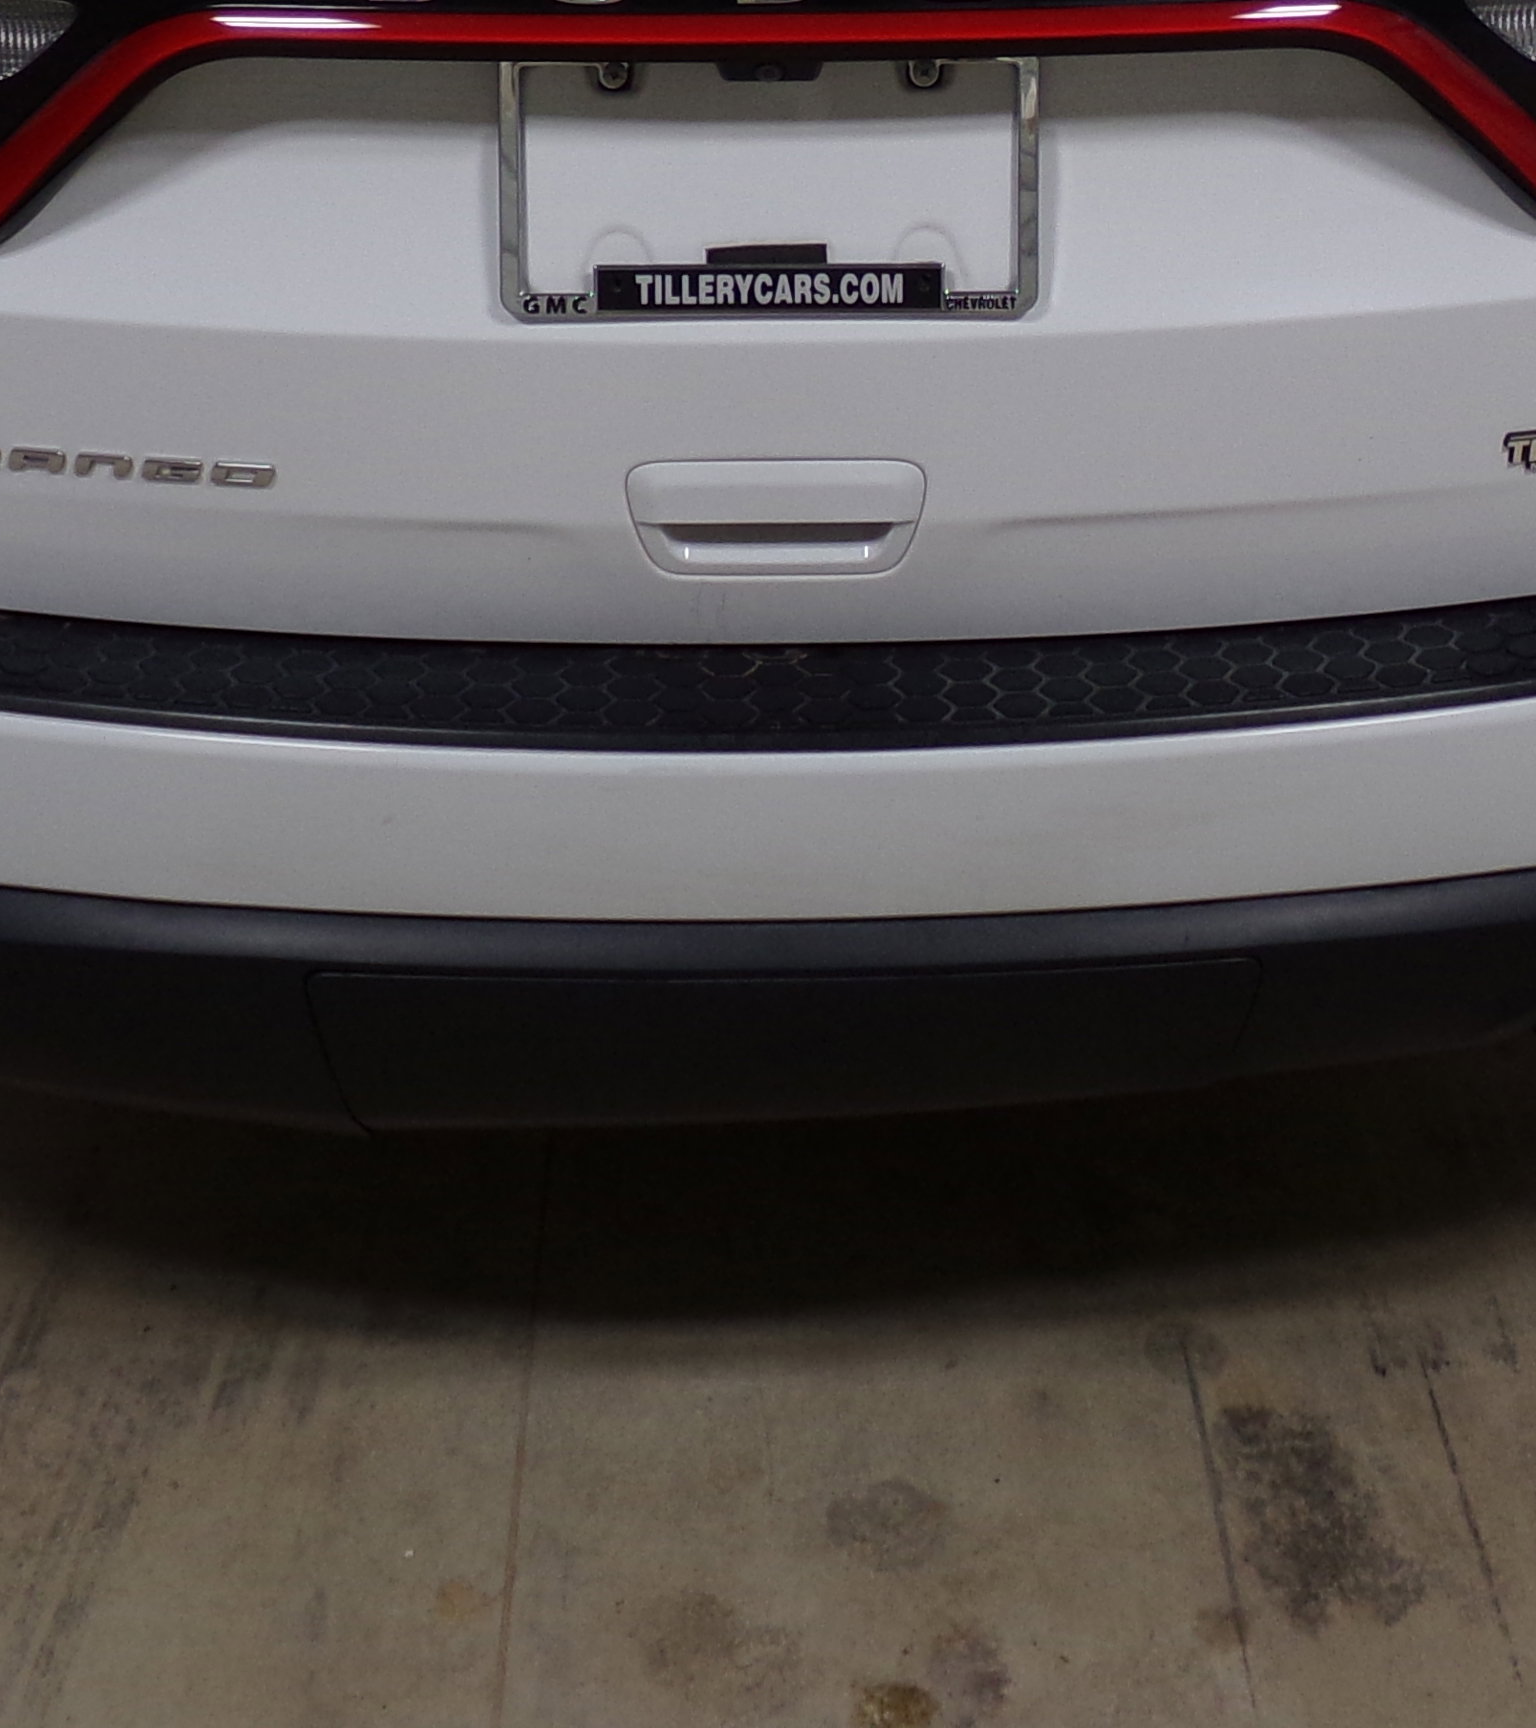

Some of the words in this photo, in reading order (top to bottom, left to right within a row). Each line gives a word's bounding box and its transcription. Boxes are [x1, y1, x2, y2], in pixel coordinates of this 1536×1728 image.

[522, 294, 590, 316] GMC
[634, 271, 906, 306] TILLERYCARS.COM
[945, 296, 1017, 311] CHEVROLET
